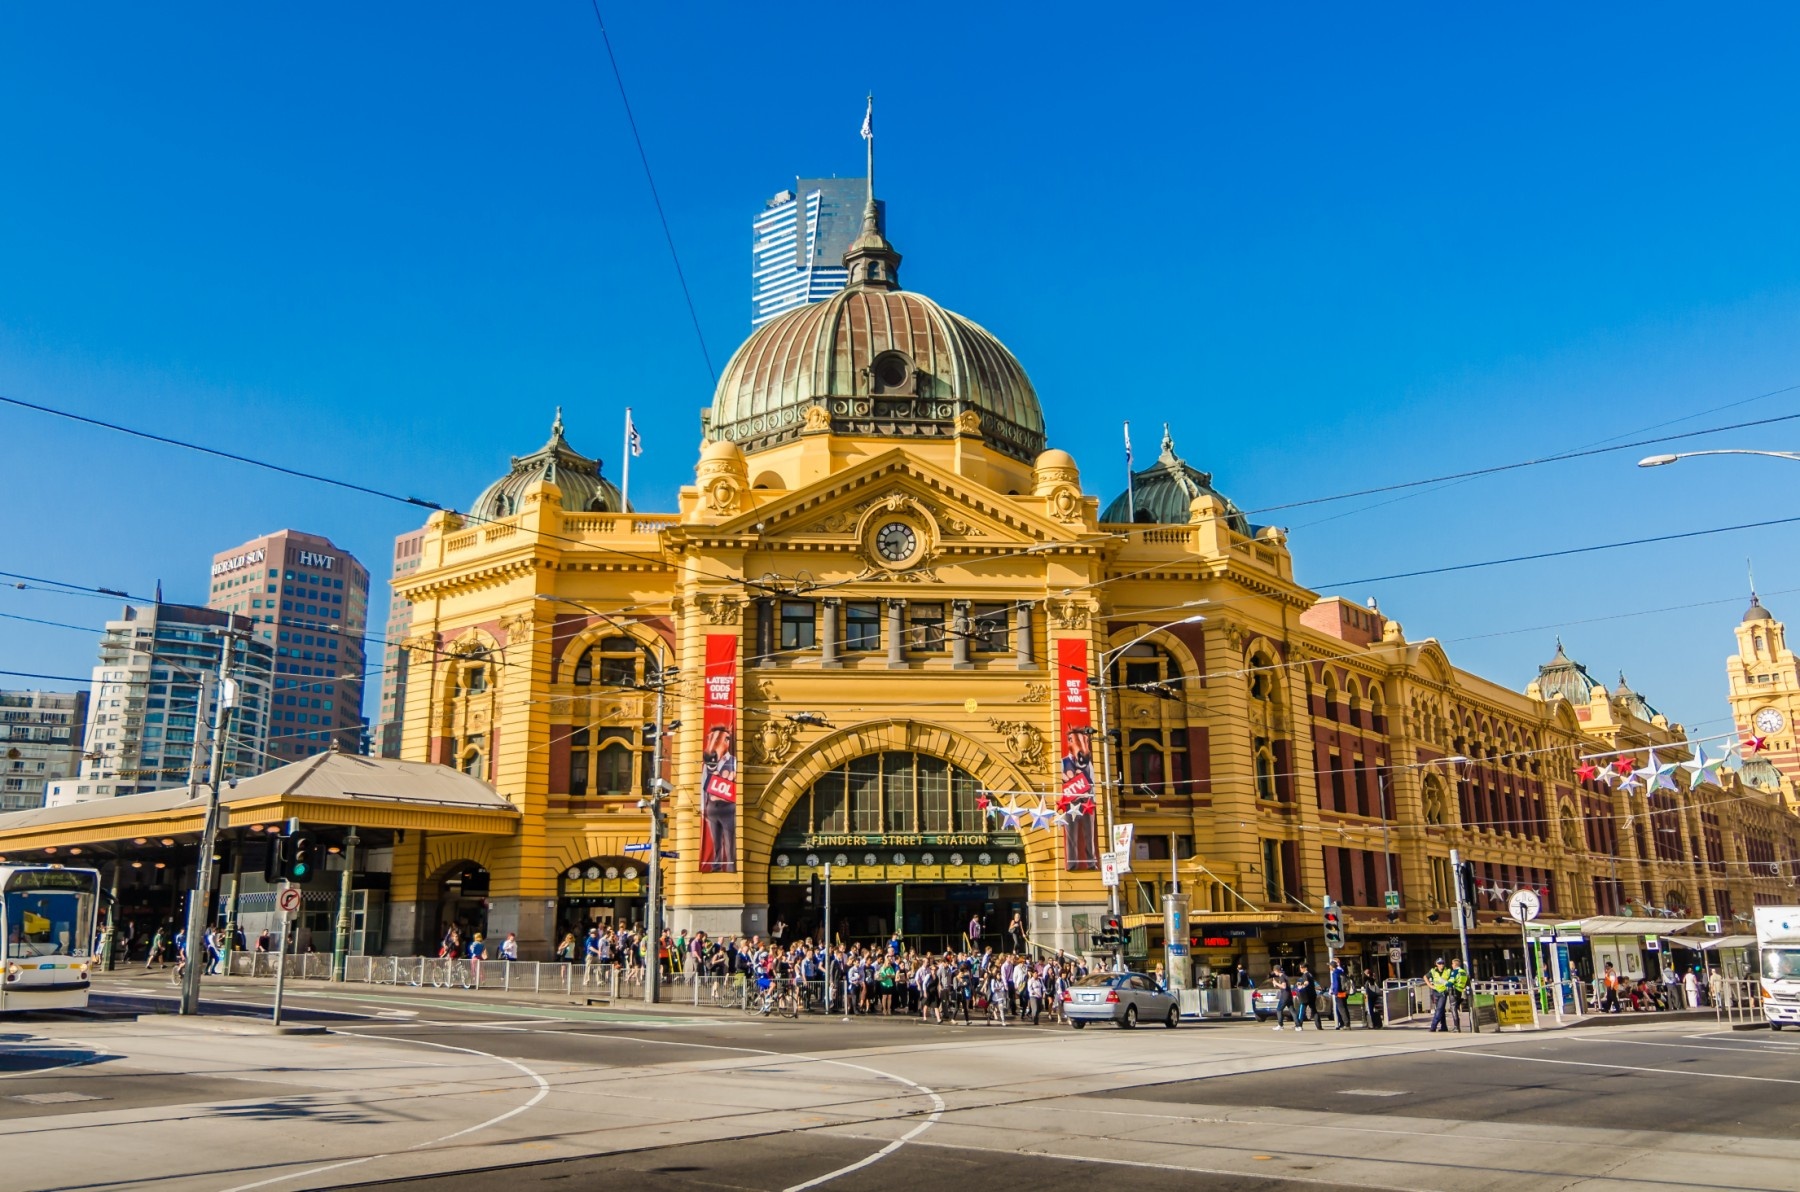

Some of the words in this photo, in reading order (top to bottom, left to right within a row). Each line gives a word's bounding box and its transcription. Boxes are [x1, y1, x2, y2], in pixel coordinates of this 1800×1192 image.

[212, 557, 245, 576] HERALD
[246, 548, 265, 567] SUN
[300, 551, 335, 569] HWT
[706, 676, 735, 684] LATEST
[709, 684, 731, 692] ODDS
[711, 692, 729, 700] LIVE
[1067, 695, 1082, 703] WIN
[711, 779, 732, 797] LOL
[1063, 778, 1086, 798] BTW
[811, 835, 868, 846] FLINDERS
[881, 835, 923, 846] STREET
[936, 835, 988, 845] STATION
